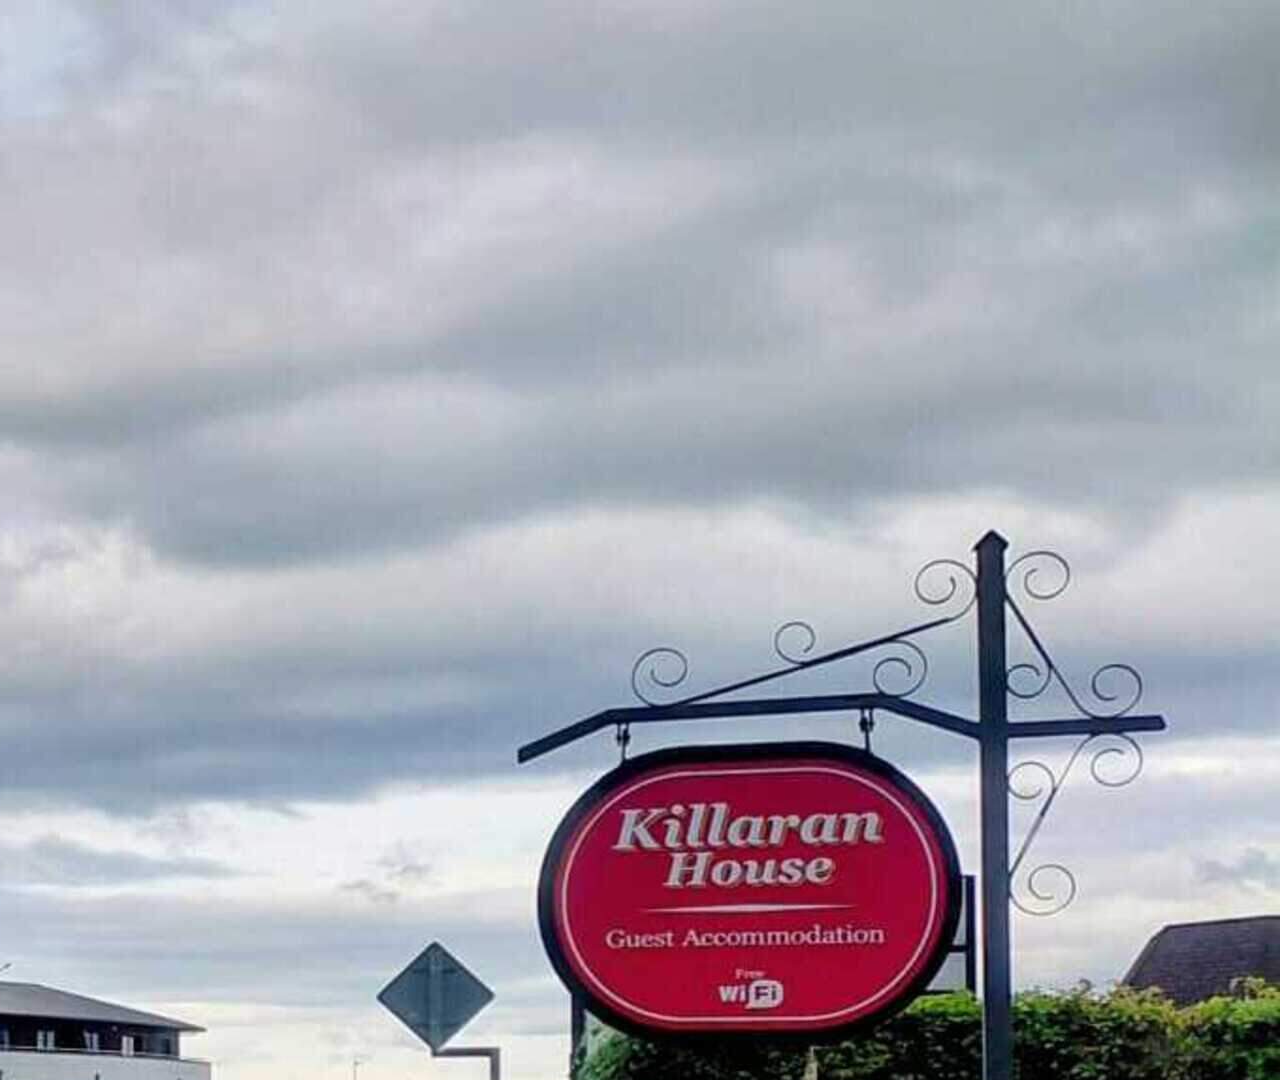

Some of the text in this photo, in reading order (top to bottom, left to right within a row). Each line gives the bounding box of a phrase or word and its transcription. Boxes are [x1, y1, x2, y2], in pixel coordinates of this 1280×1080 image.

[612, 802, 885, 850] Killaran
[662, 851, 835, 888] House
[605, 924, 886, 949] Guest Accommodation
